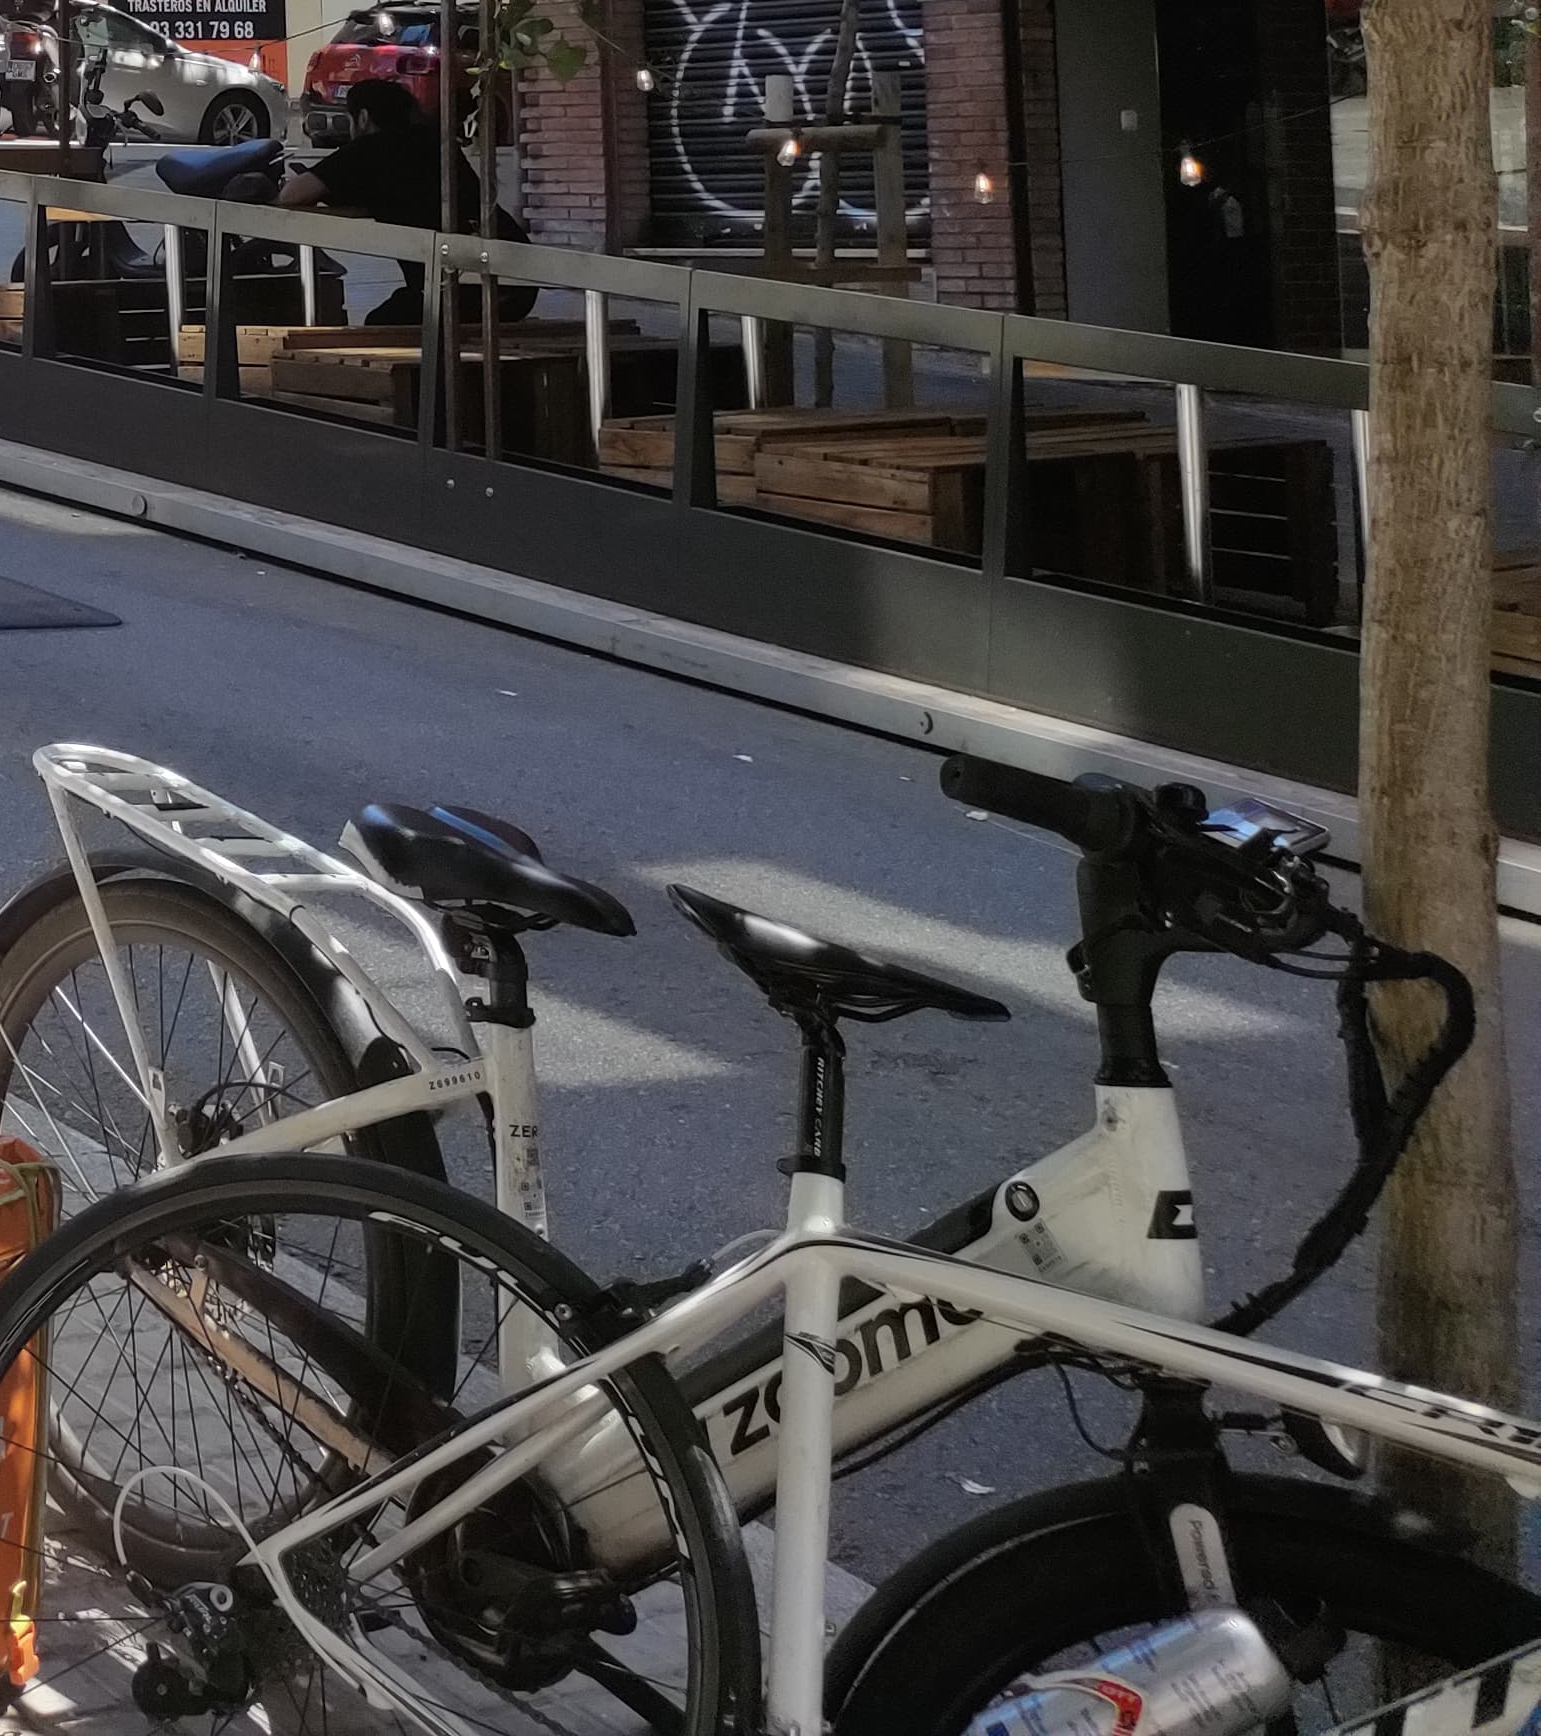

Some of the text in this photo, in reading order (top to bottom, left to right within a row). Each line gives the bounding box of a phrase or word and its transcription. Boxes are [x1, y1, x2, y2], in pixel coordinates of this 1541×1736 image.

[127, 0, 267, 13] TRASTEROS EN ALQUILER
[174, 21, 203, 39] 331
[210, 21, 230, 39] 79
[234, 21, 254, 39] 68
